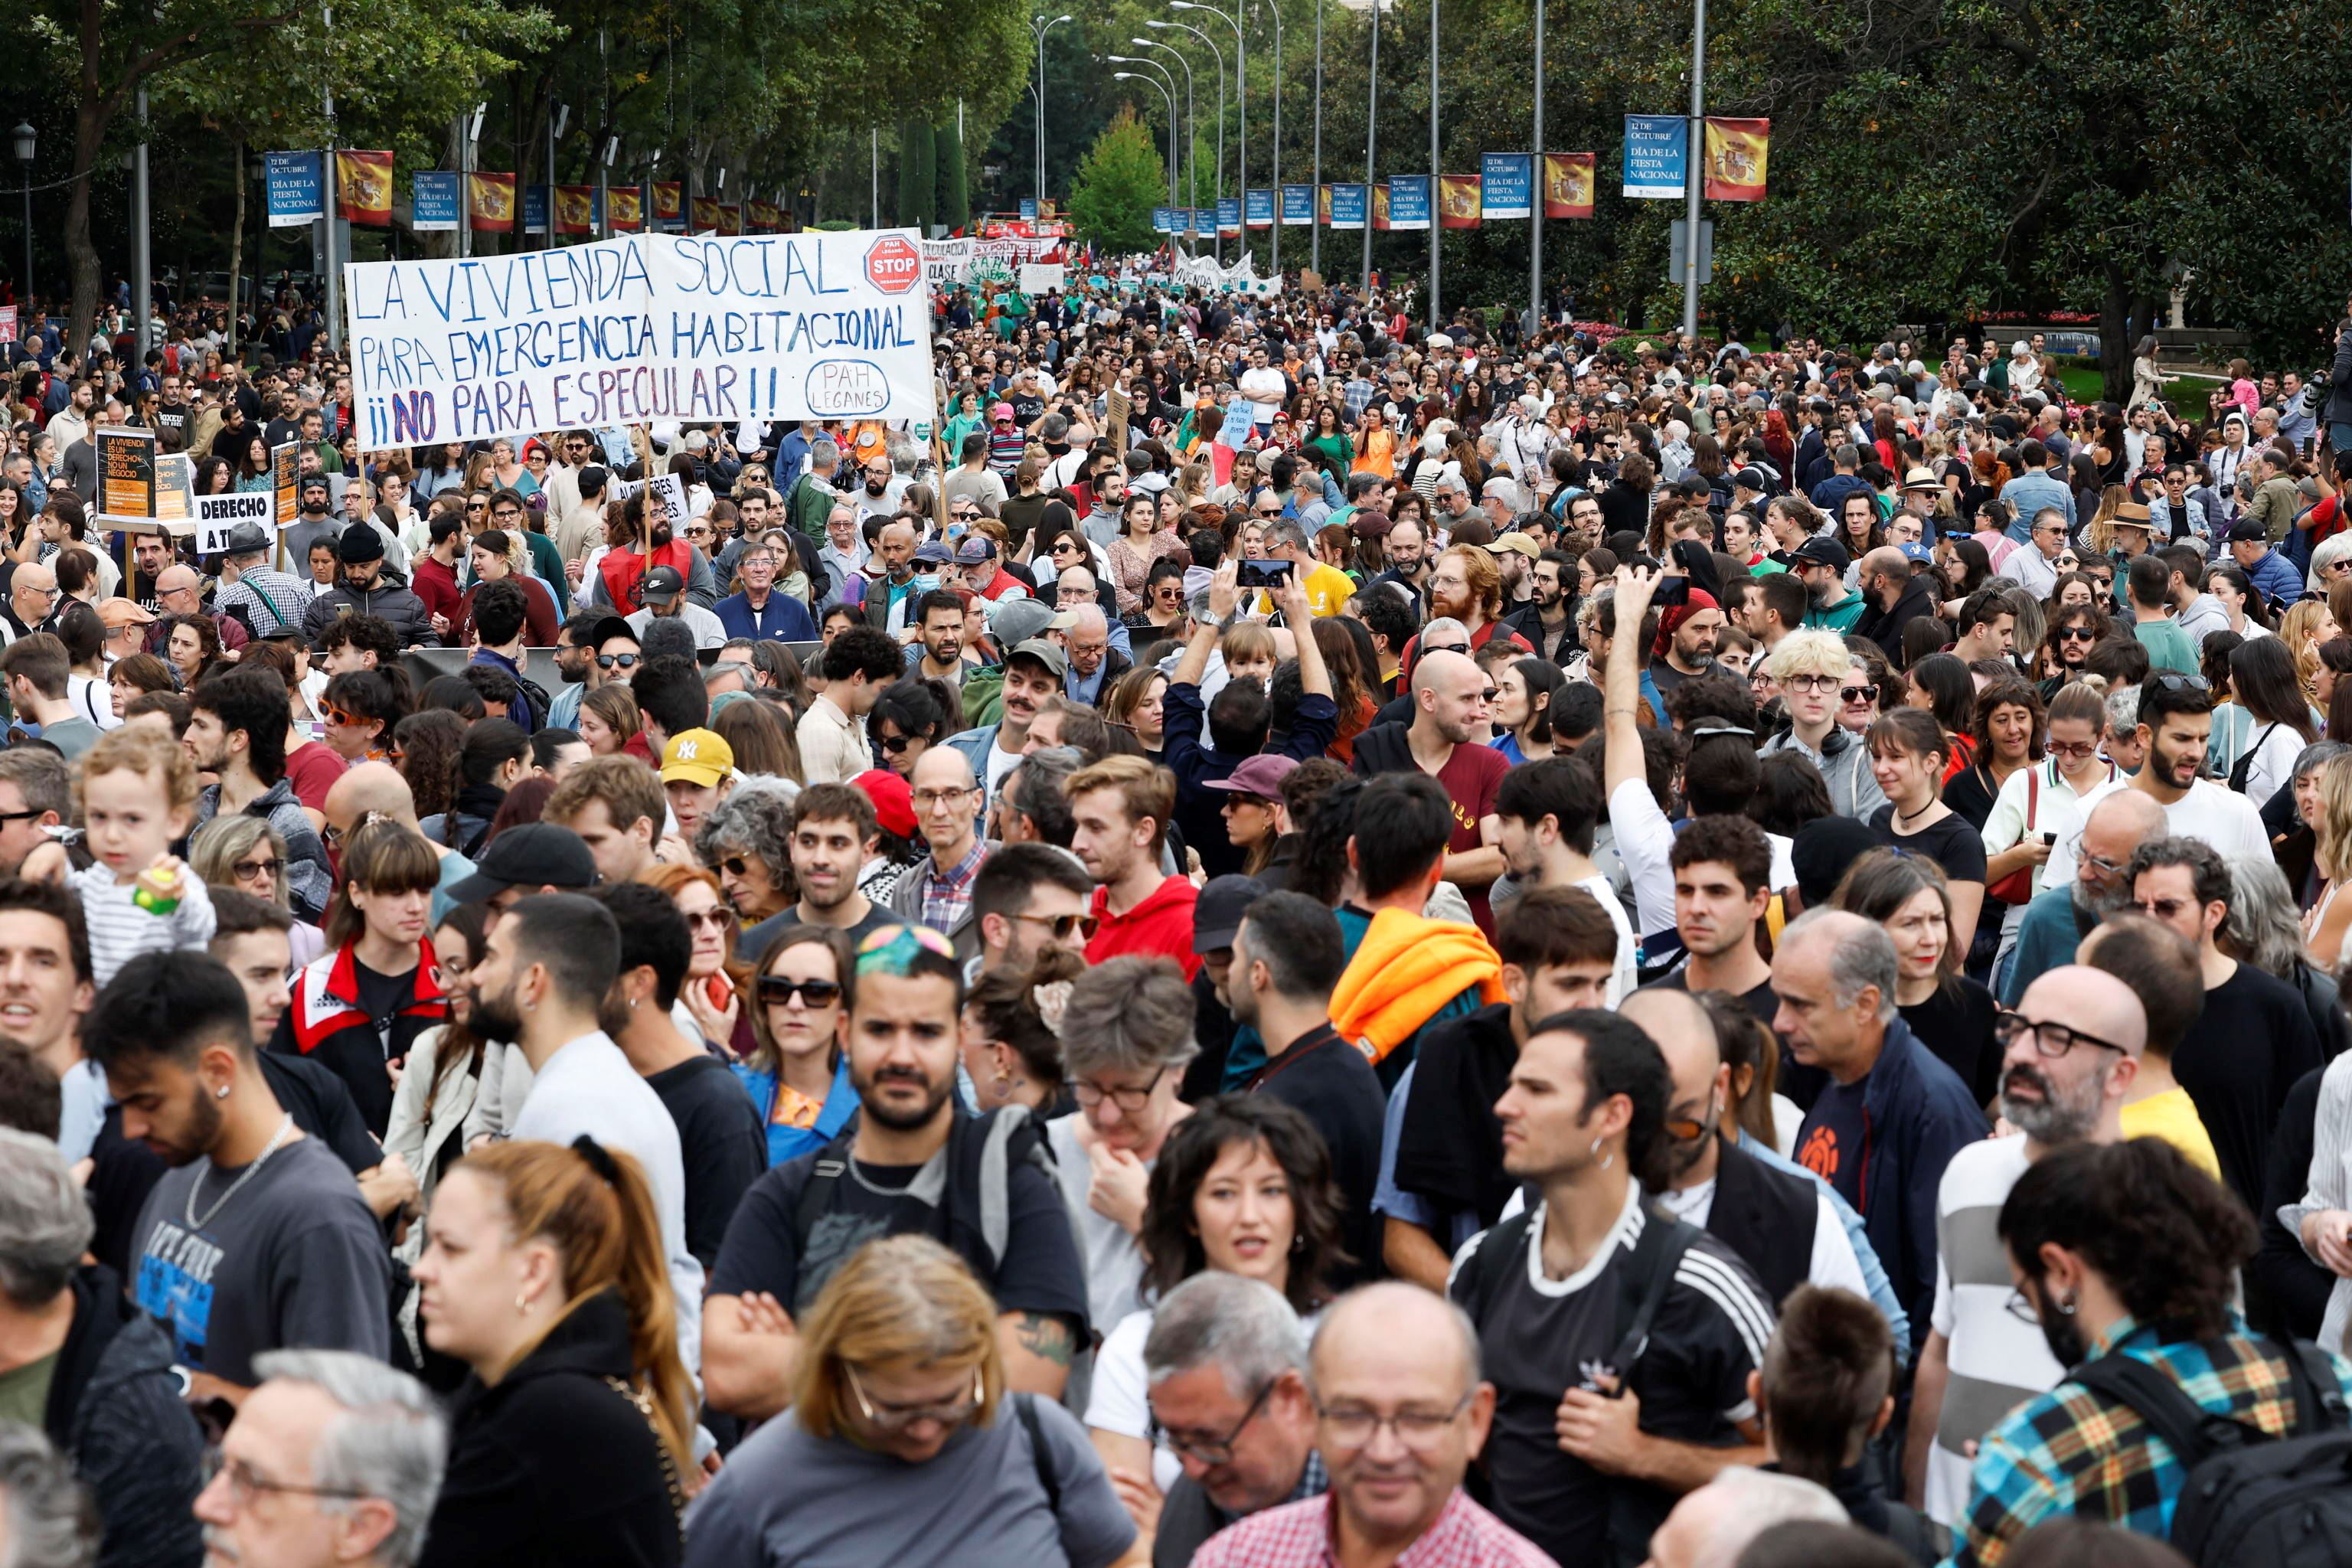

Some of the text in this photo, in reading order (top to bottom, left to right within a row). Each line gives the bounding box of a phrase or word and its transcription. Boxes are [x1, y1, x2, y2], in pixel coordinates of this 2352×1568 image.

[1631, 147, 1678, 157] DÍA DE LA
[271, 165, 307, 174] OCTUBRE
[1631, 159, 1662, 168] FIESTA
[272, 179, 288, 188] DÍA
[1630, 171, 1681, 180] NACIONAL
[273, 200, 319, 208] NACIONAL
[874, 257, 915, 274] STOP
[929, 264, 957, 280] CLASE
[354, 238, 849, 322] LA VIVIENDA SOCIAL
[360, 305, 916, 392] PARA EMERGENCIA HABITACIONAL
[823, 364, 869, 389] PAH
[812, 390, 884, 409] LEGANES
[452, 381, 537, 436] PARA
[116, 439, 145, 448] VIVIENDA
[108, 453, 137, 462] DERECHO
[201, 497, 266, 520] DERECHO
[207, 531, 217, 549] A
